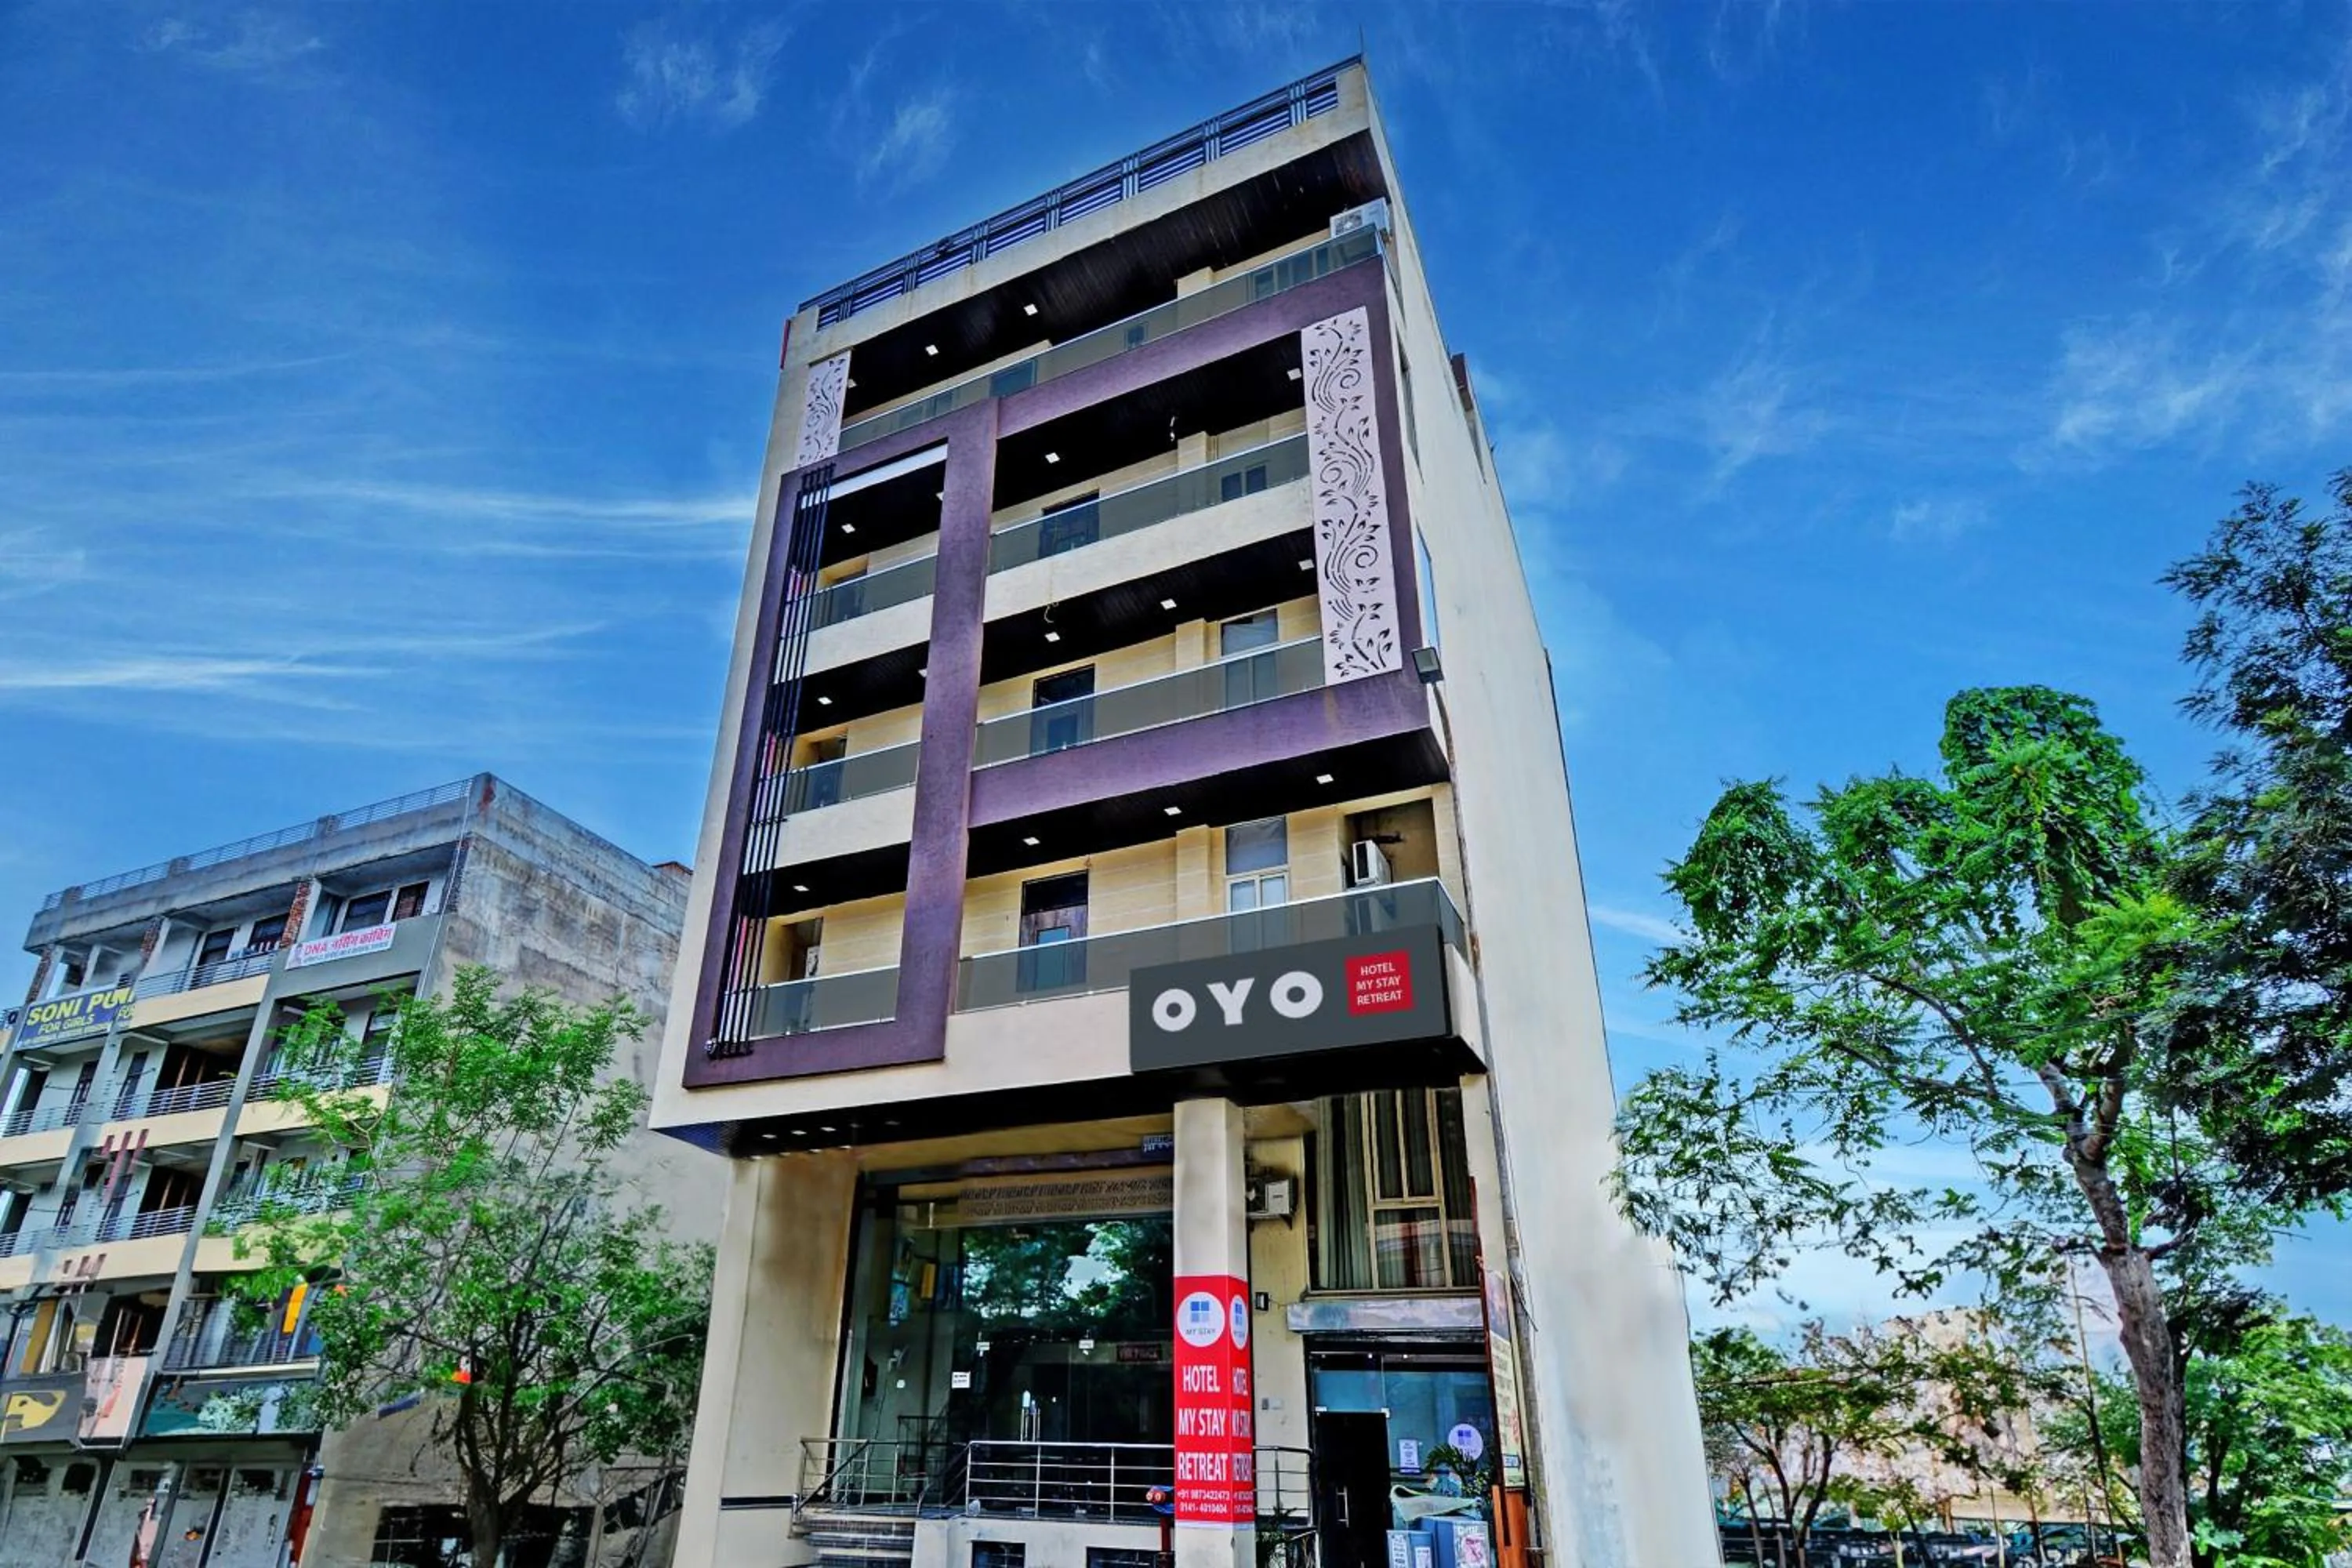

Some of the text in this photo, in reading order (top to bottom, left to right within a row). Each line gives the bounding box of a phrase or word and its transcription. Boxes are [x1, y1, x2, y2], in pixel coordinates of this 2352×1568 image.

[1360, 960, 1396, 976] HOTEL
[1356, 975, 1401, 992] MY STAY
[1152, 971, 1323, 1033] OYO
[1357, 989, 1403, 1006] RETREAT
[27, 997, 83, 1026] SONI
[1182, 1365, 1221, 1392] HOTEL
[1178, 1408, 1197, 1436] MY
[1198, 1408, 1227, 1436] STAY
[1178, 1452, 1229, 1482] RETREAT
